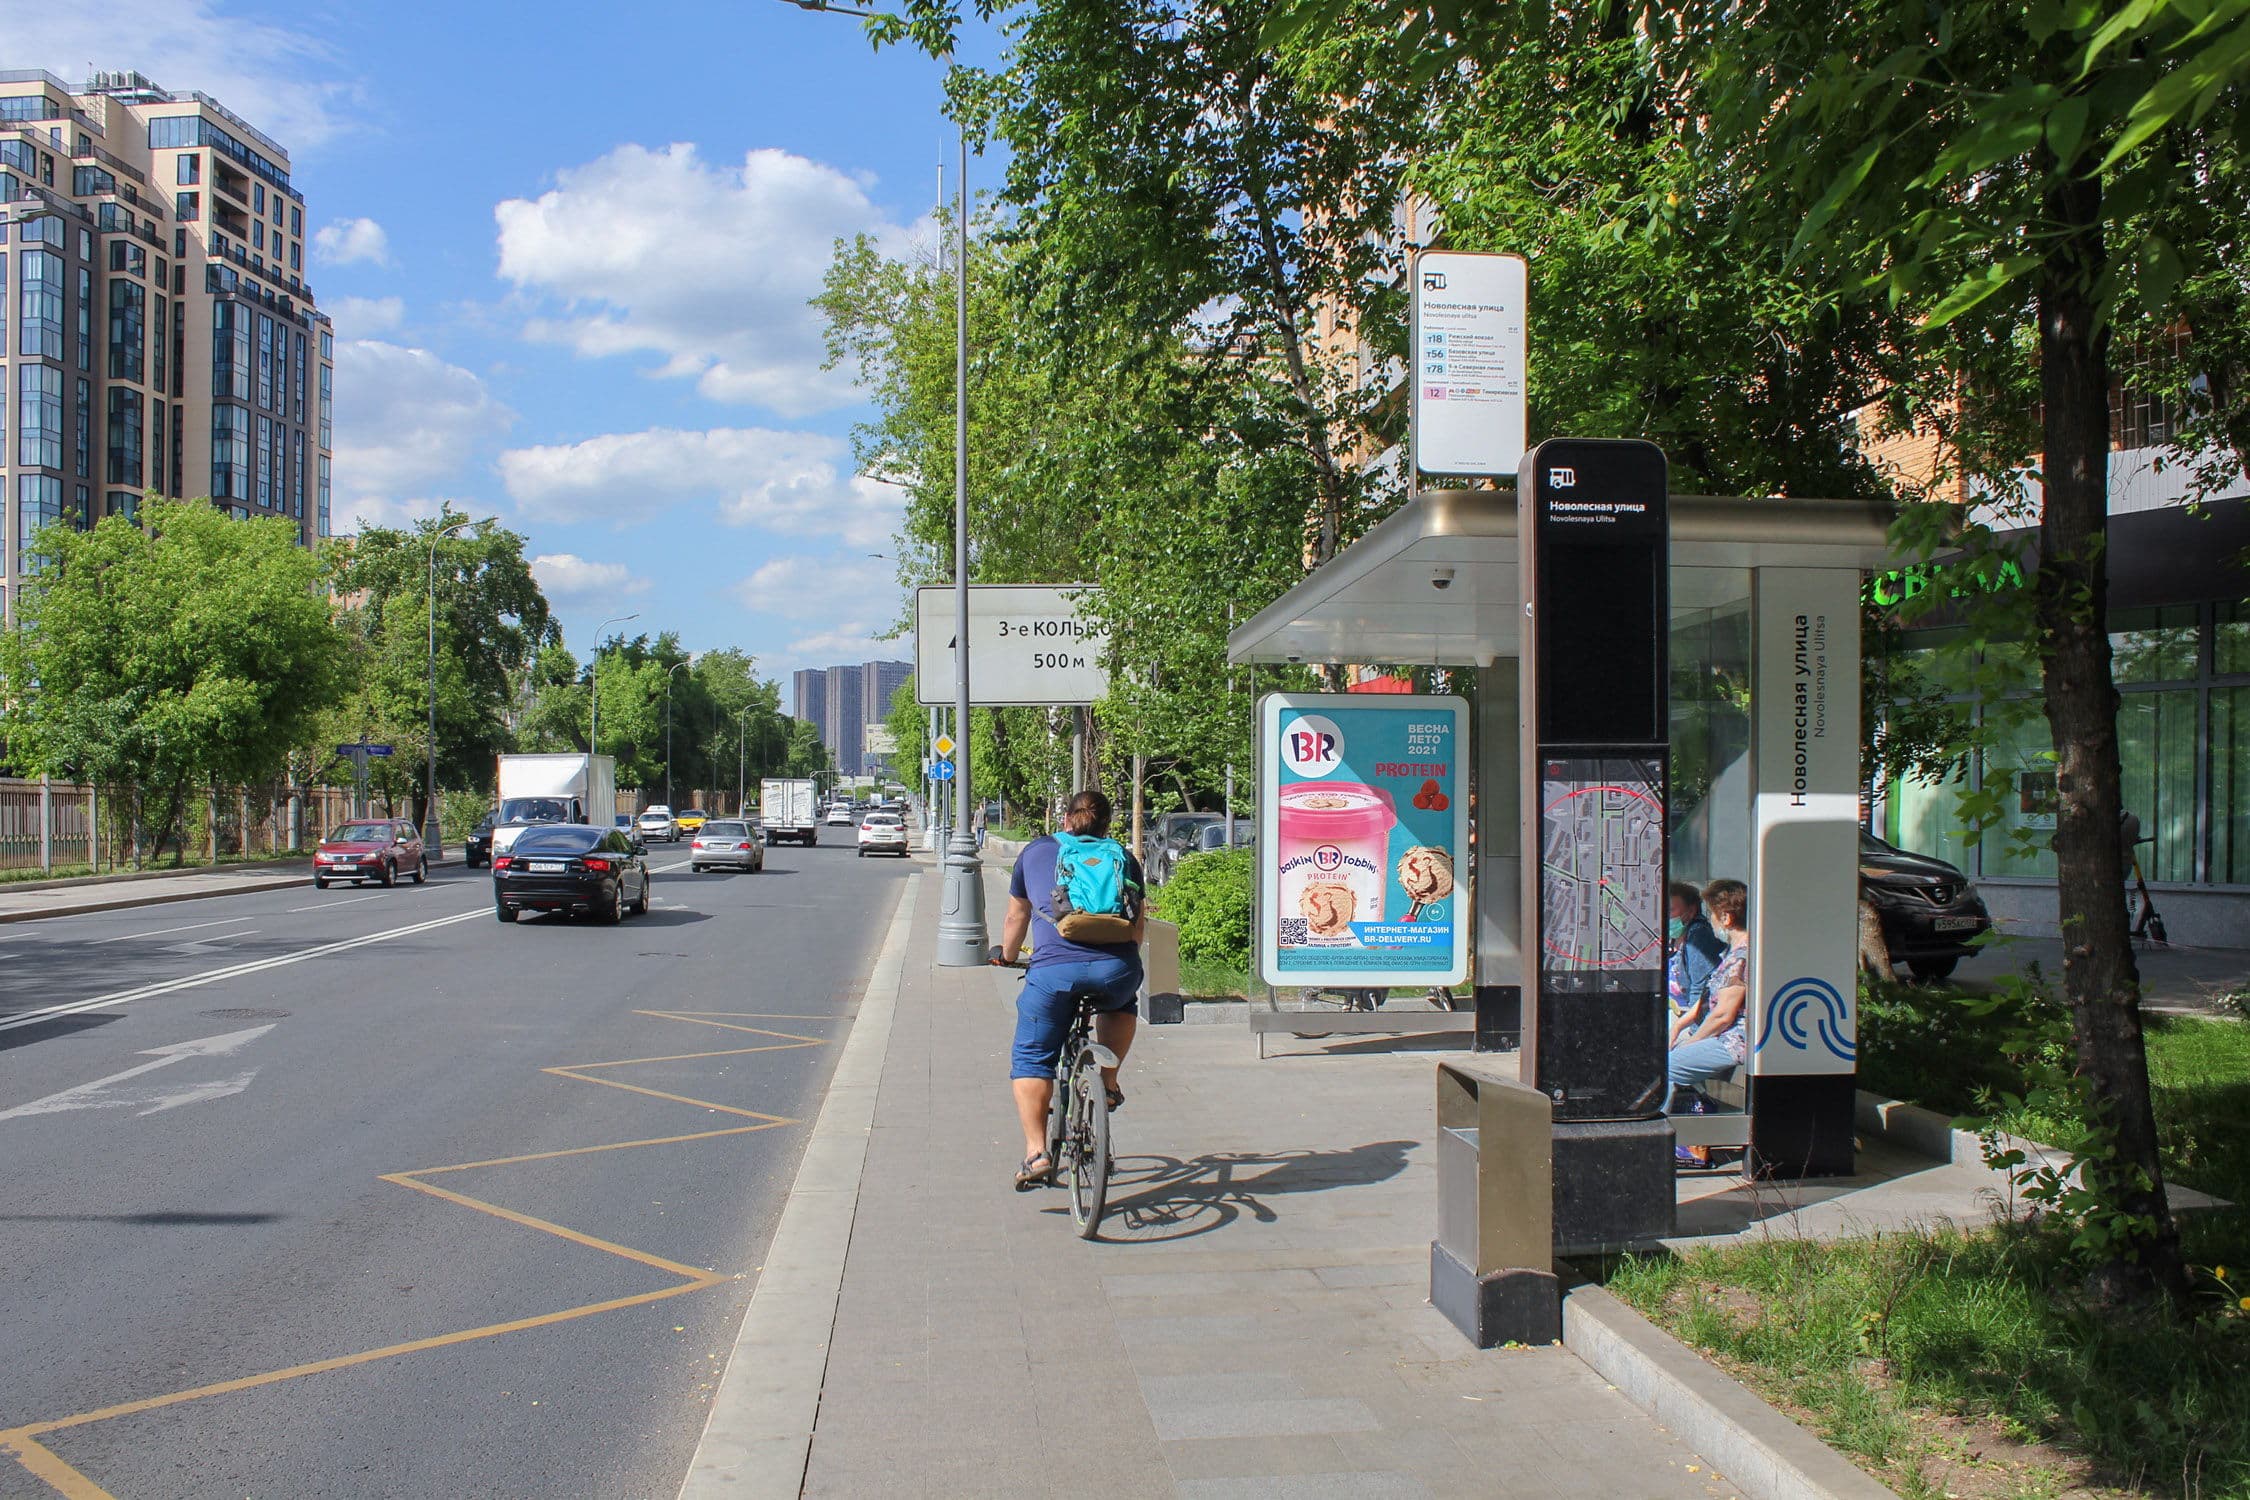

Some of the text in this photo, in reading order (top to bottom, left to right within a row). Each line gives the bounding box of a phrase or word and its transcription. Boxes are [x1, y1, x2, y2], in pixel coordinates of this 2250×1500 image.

[1424, 301, 1505, 312] Новолесная улица
[1430, 389, 1440, 397] 12
[1549, 501, 1646, 513] Новолесная улица
[1550, 515, 1595, 523] Novolesnaya
[999, 621, 1029, 636] 3-е
[1034, 653, 1068, 668] 500
[1814, 615, 1827, 737] Novolesnaya Ulitsa
[1791, 615, 1811, 806] Новолесная улица
[1408, 724, 1449, 733] ВЕСНА
[1408, 735, 1441, 744] ЛЕТО
[1291, 732, 1335, 762] BR
[1408, 746, 1437, 754] 2021
[1376, 763, 1446, 776] PROTEIN
[1364, 926, 1449, 934] ИНТЕРНЕТ-МАГАЗИН
